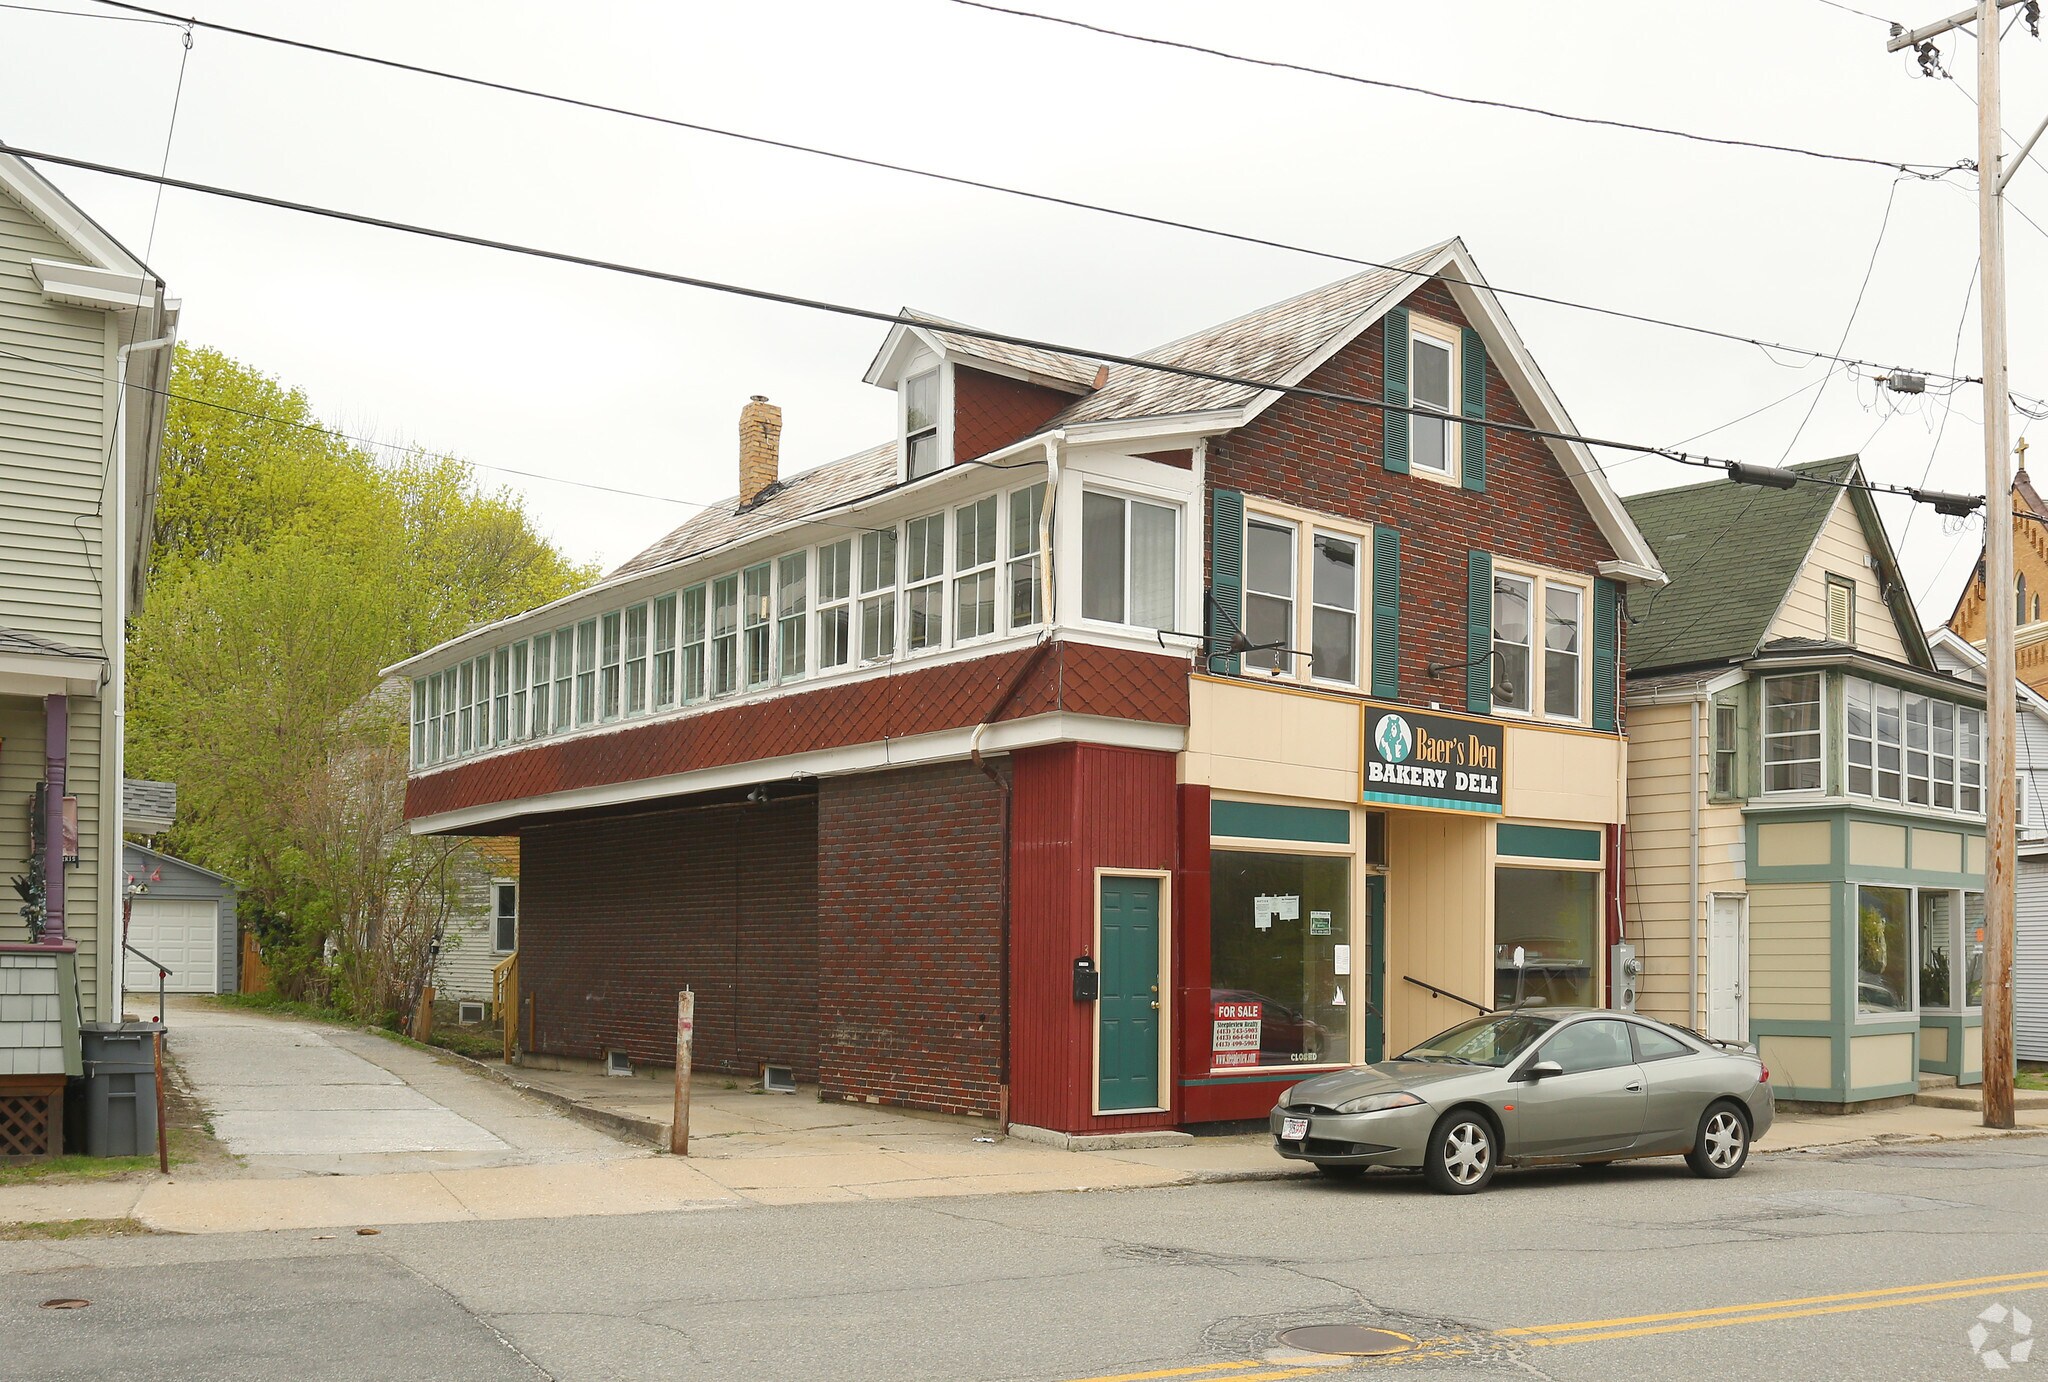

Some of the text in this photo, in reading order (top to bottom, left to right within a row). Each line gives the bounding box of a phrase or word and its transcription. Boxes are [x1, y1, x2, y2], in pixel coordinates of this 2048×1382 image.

[1415, 727, 1497, 770] Baer's Den
[1368, 761, 1498, 795] BAKERY DELI
[1218, 1006, 1258, 1018] FOR SALE
[1290, 1052, 1318, 1062] CLOSED
